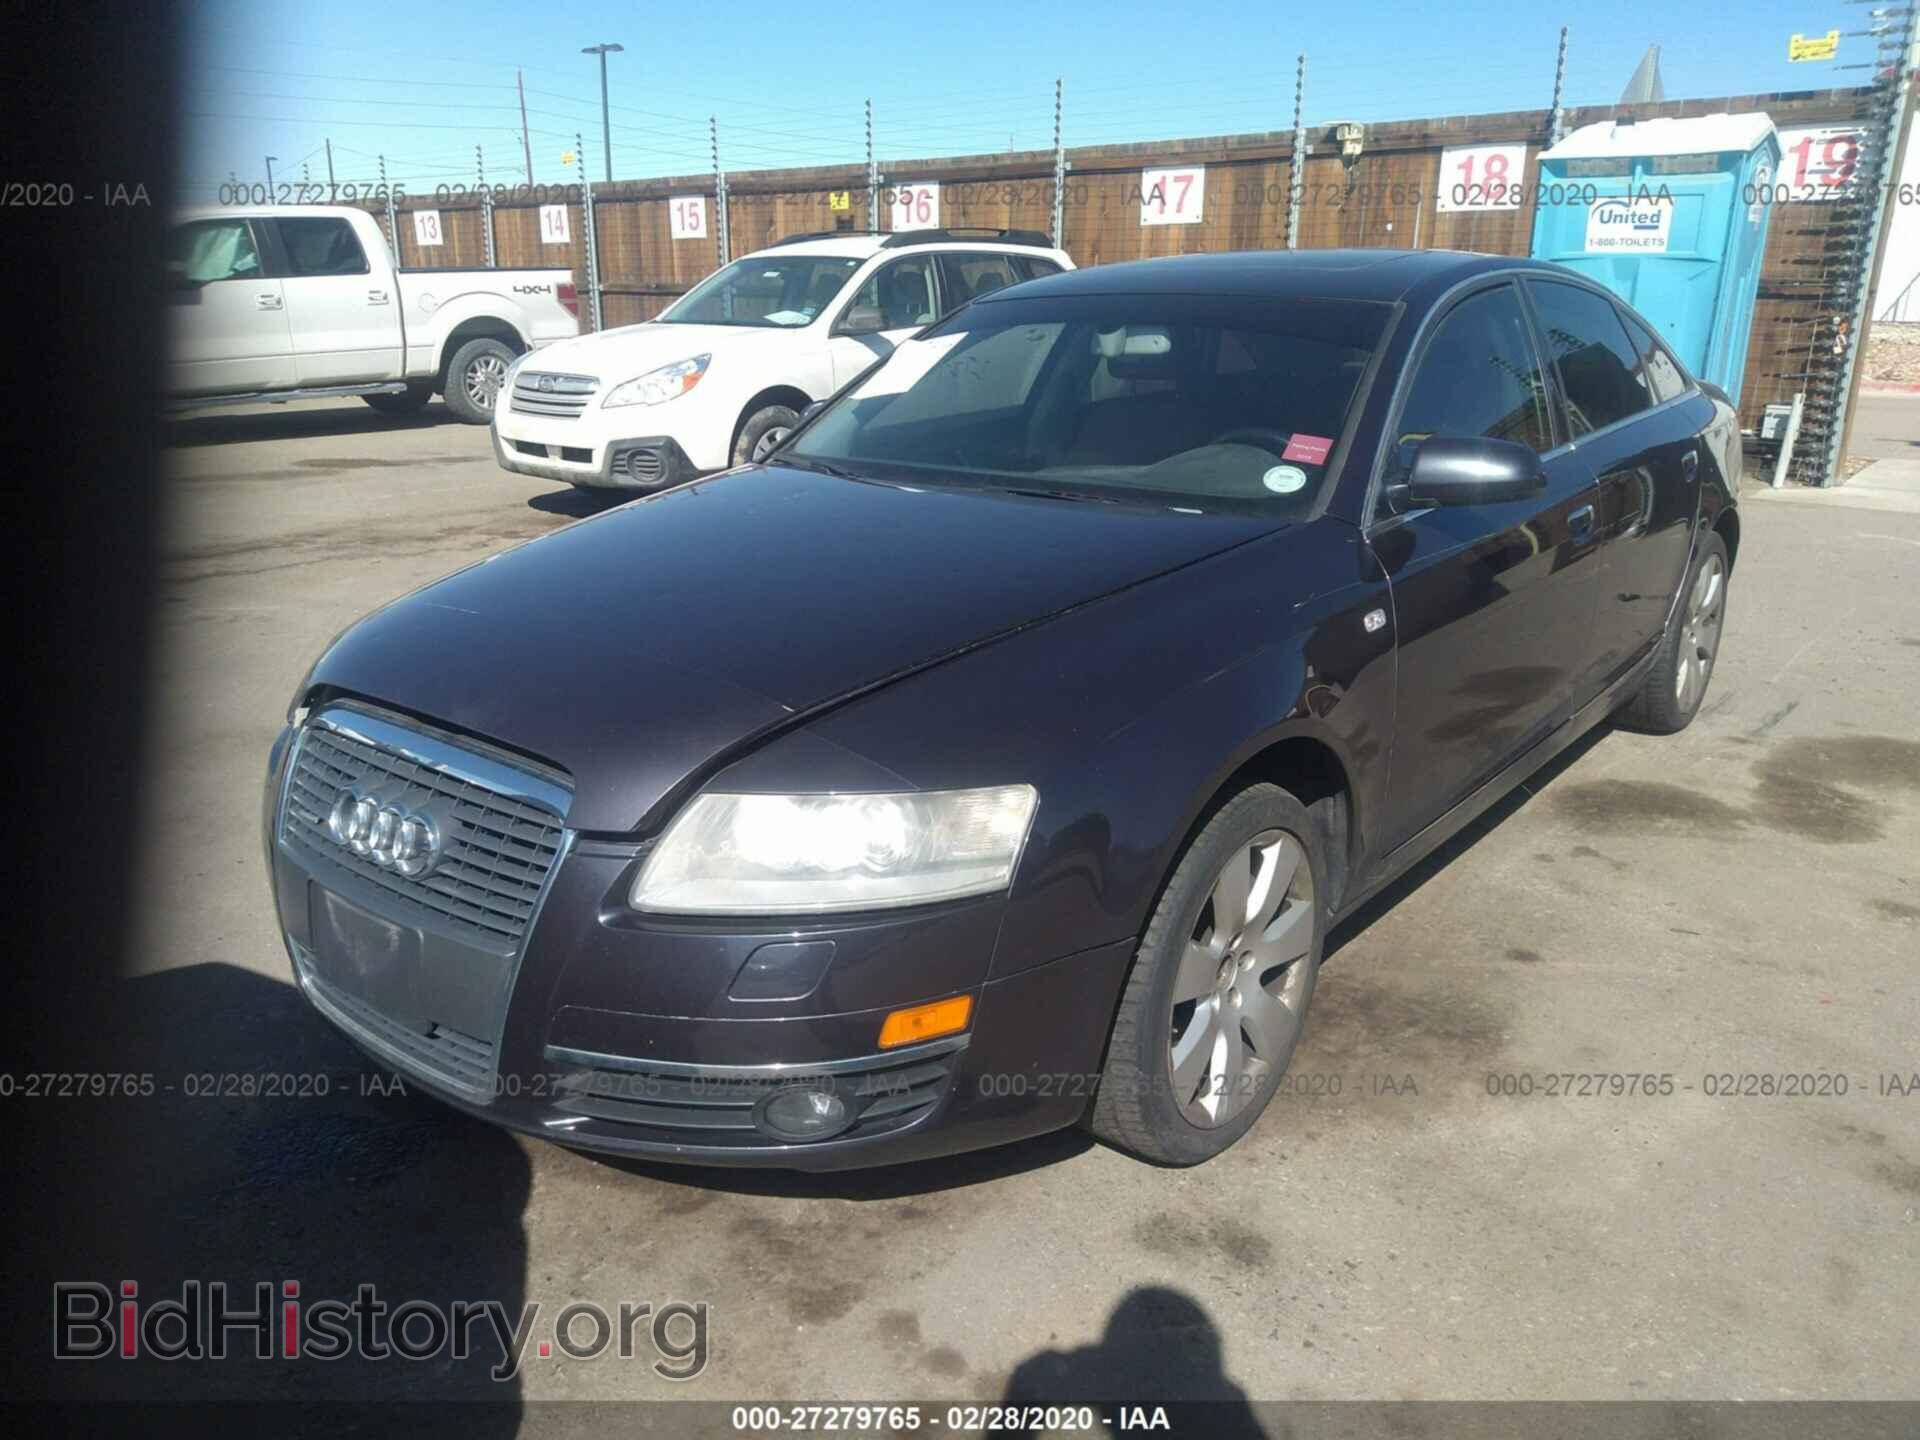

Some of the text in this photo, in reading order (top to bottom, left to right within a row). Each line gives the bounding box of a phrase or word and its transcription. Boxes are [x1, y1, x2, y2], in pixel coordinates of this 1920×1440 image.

[1456, 153, 1510, 200] 18
[1788, 134, 1858, 190] 19
[902, 188, 932, 224] 16
[1157, 175, 1195, 214] 17
[418, 215, 438, 239] 13
[544, 209, 565, 235] 14
[676, 201, 701, 232] 15
[1599, 208, 1662, 225] United
